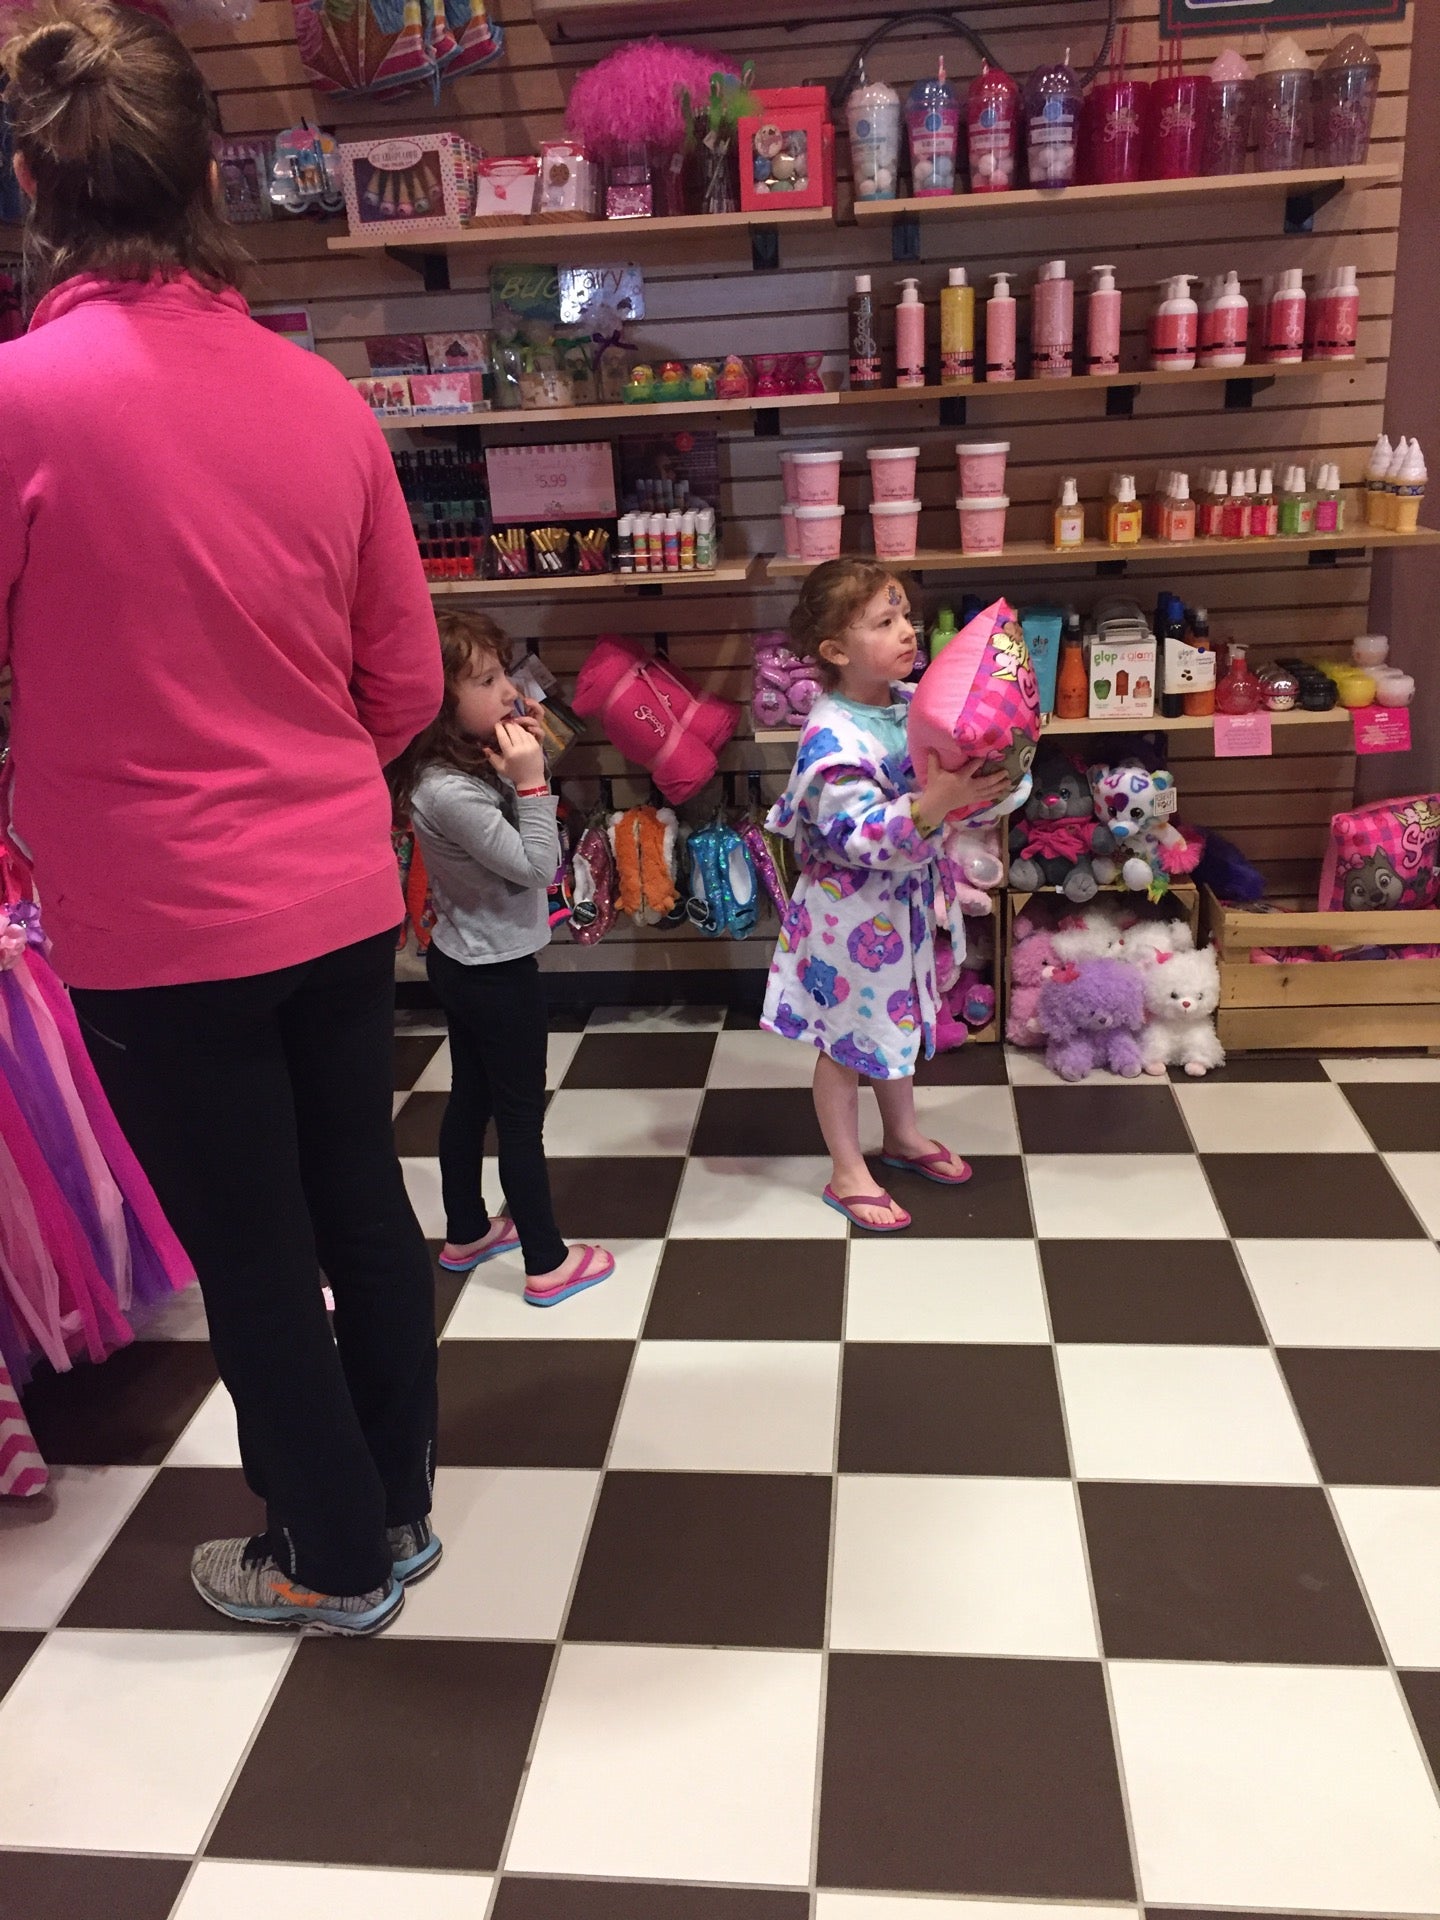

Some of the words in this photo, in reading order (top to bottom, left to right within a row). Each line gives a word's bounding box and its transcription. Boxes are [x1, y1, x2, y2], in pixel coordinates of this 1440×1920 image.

[572, 268, 623, 293] Fairy
[1094, 650, 1118, 667] glop
[1127, 651, 1154, 662] glam
[635, 706, 665, 737] Scoops
